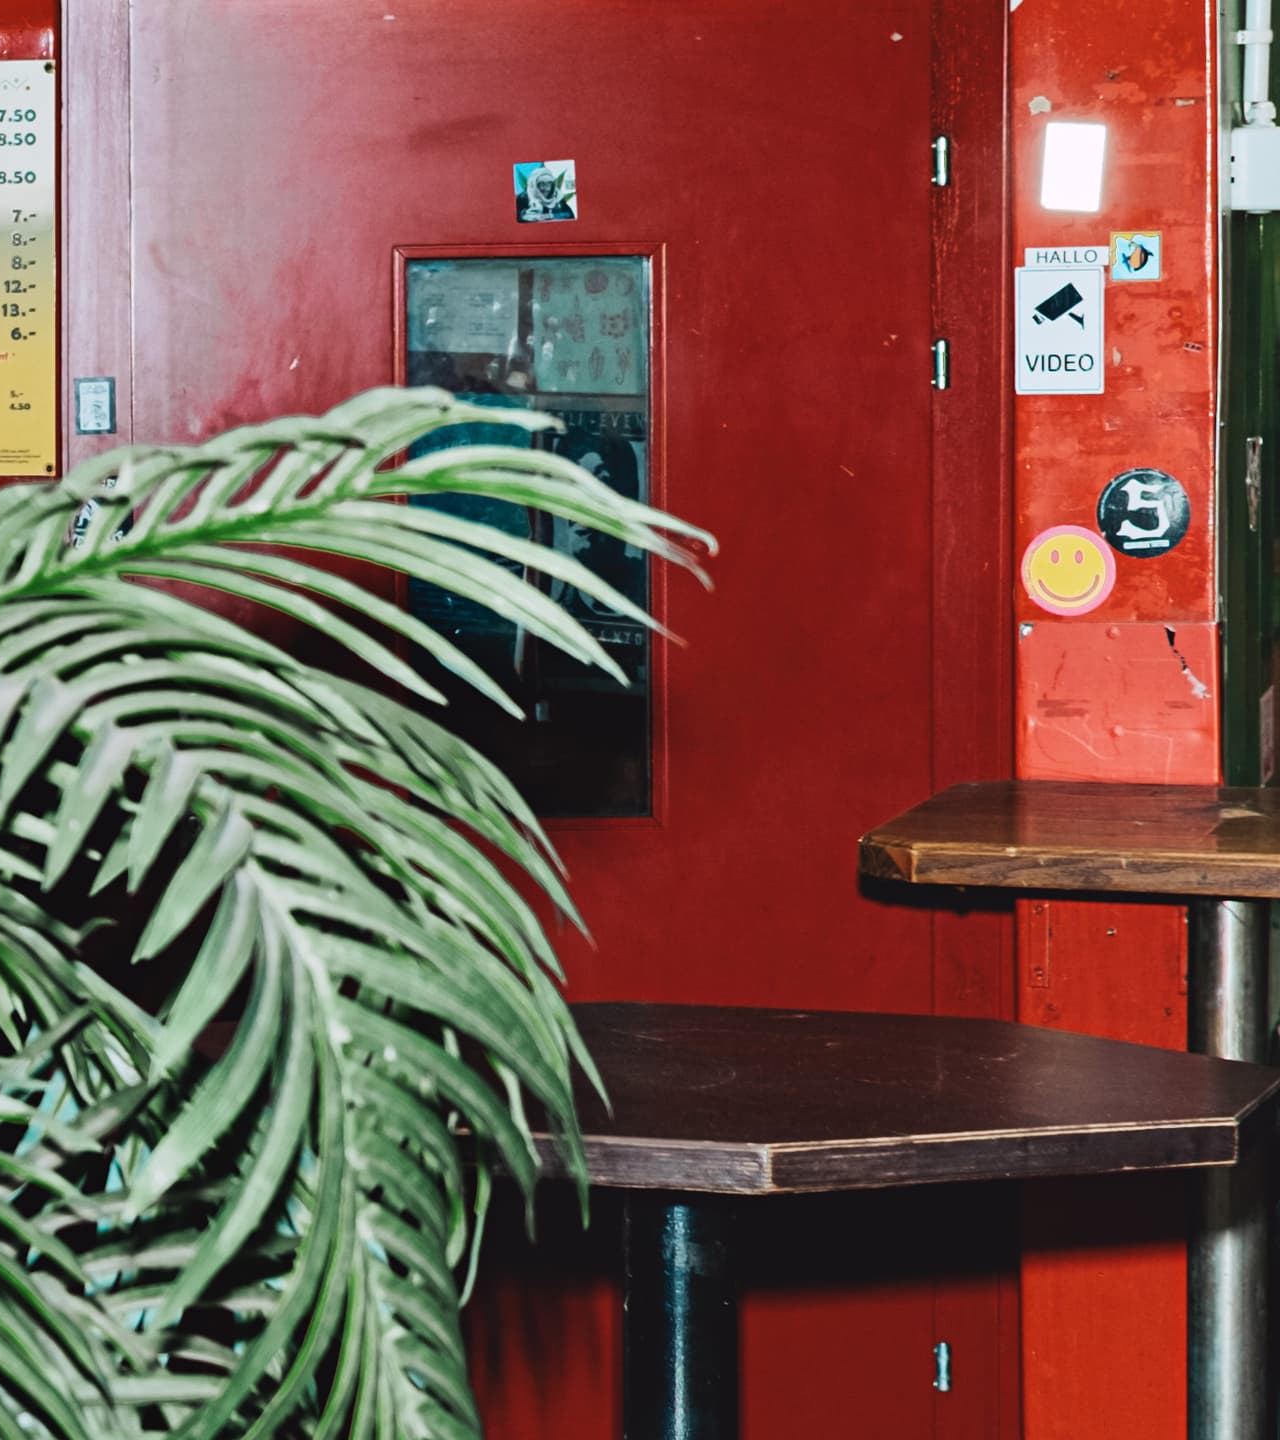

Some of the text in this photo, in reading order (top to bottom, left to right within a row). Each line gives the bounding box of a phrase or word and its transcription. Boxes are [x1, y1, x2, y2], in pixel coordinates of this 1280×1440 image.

[12, 209, 37, 222] 7.-
[12, 233, 36, 246] 8.-
[11, 256, 36, 270] 8.-
[1036, 250, 1098, 263] HALLO
[4, 280, 36, 294] 12.-
[2, 304, 36, 317] 13.-
[11, 327, 36, 341] 6.-
[1026, 354, 1094, 372] VIDEO
